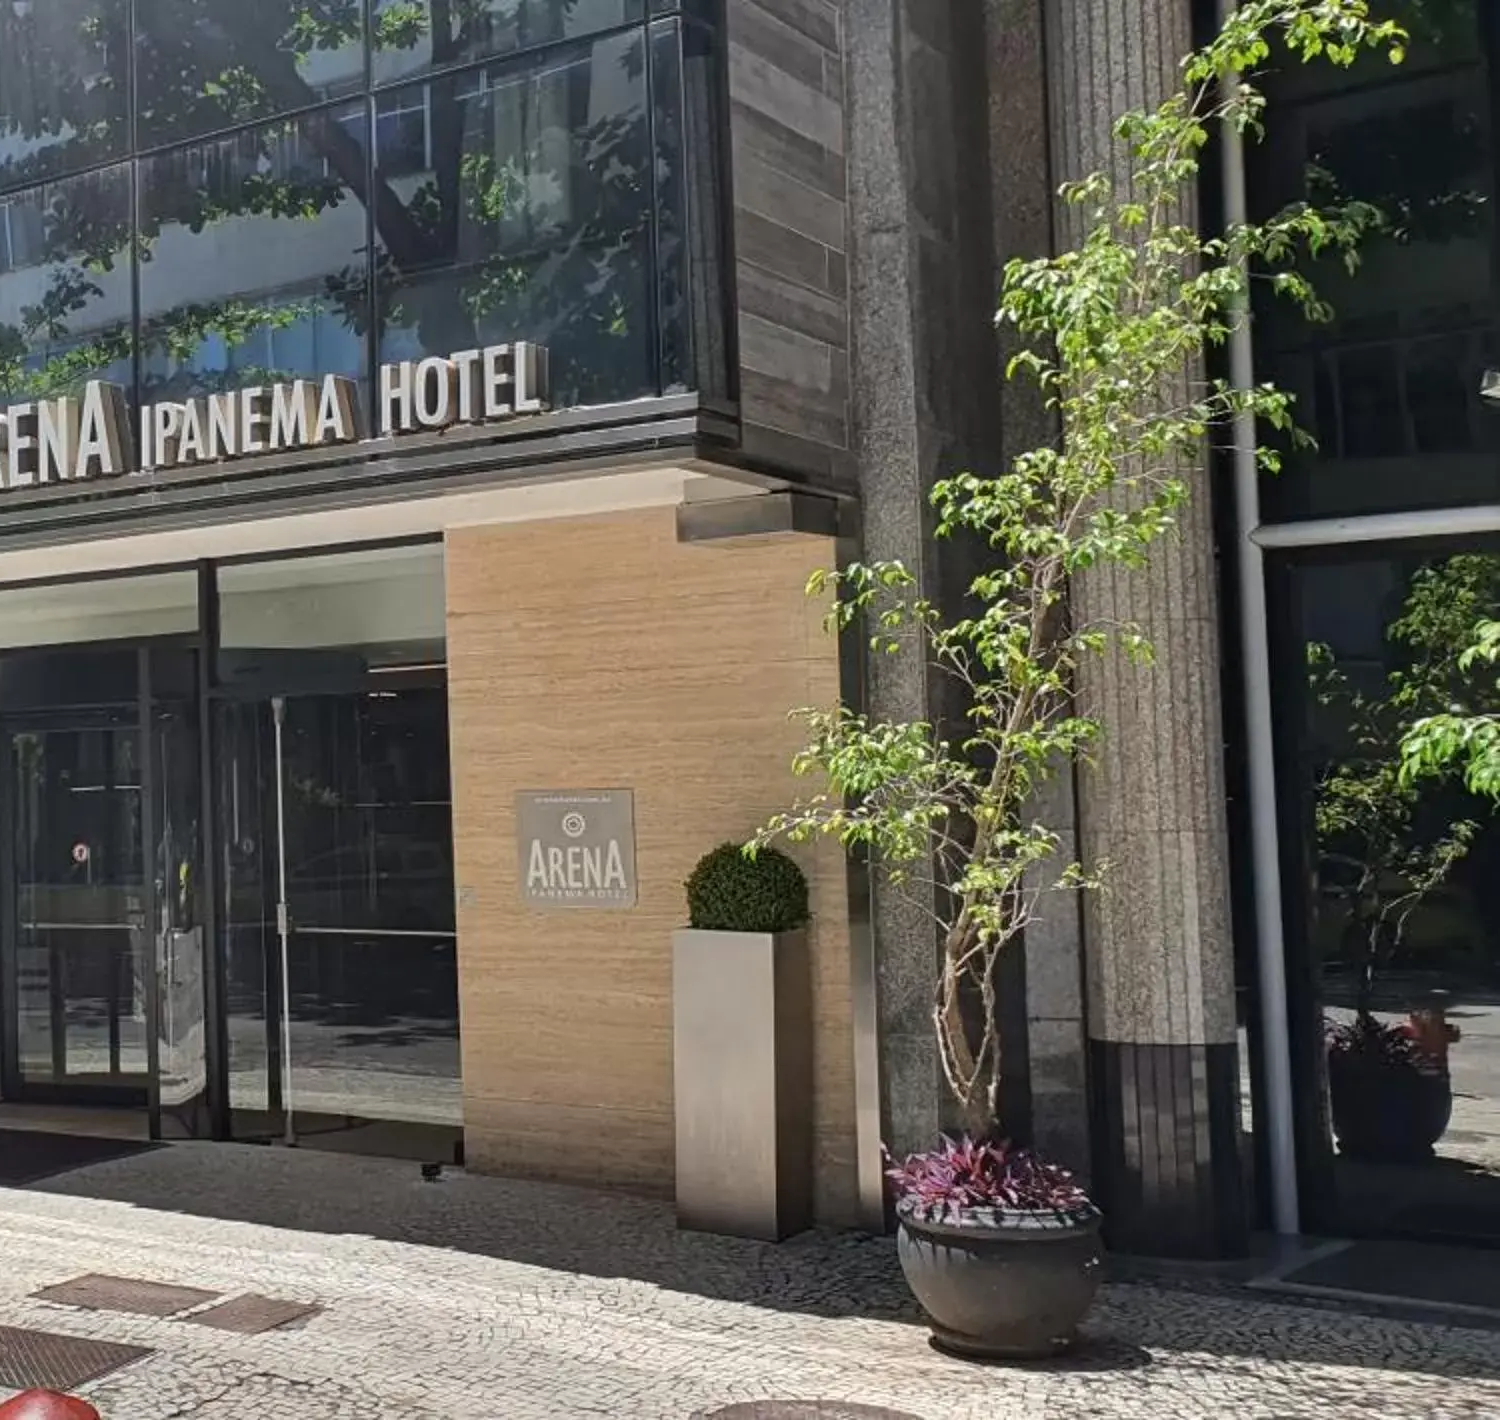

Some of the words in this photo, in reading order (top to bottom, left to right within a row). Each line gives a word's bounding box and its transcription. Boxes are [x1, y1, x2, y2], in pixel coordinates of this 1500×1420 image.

[141, 374, 347, 468] IPANEMA
[381, 341, 542, 432] HOTEL
[527, 838, 627, 889] ARENA
